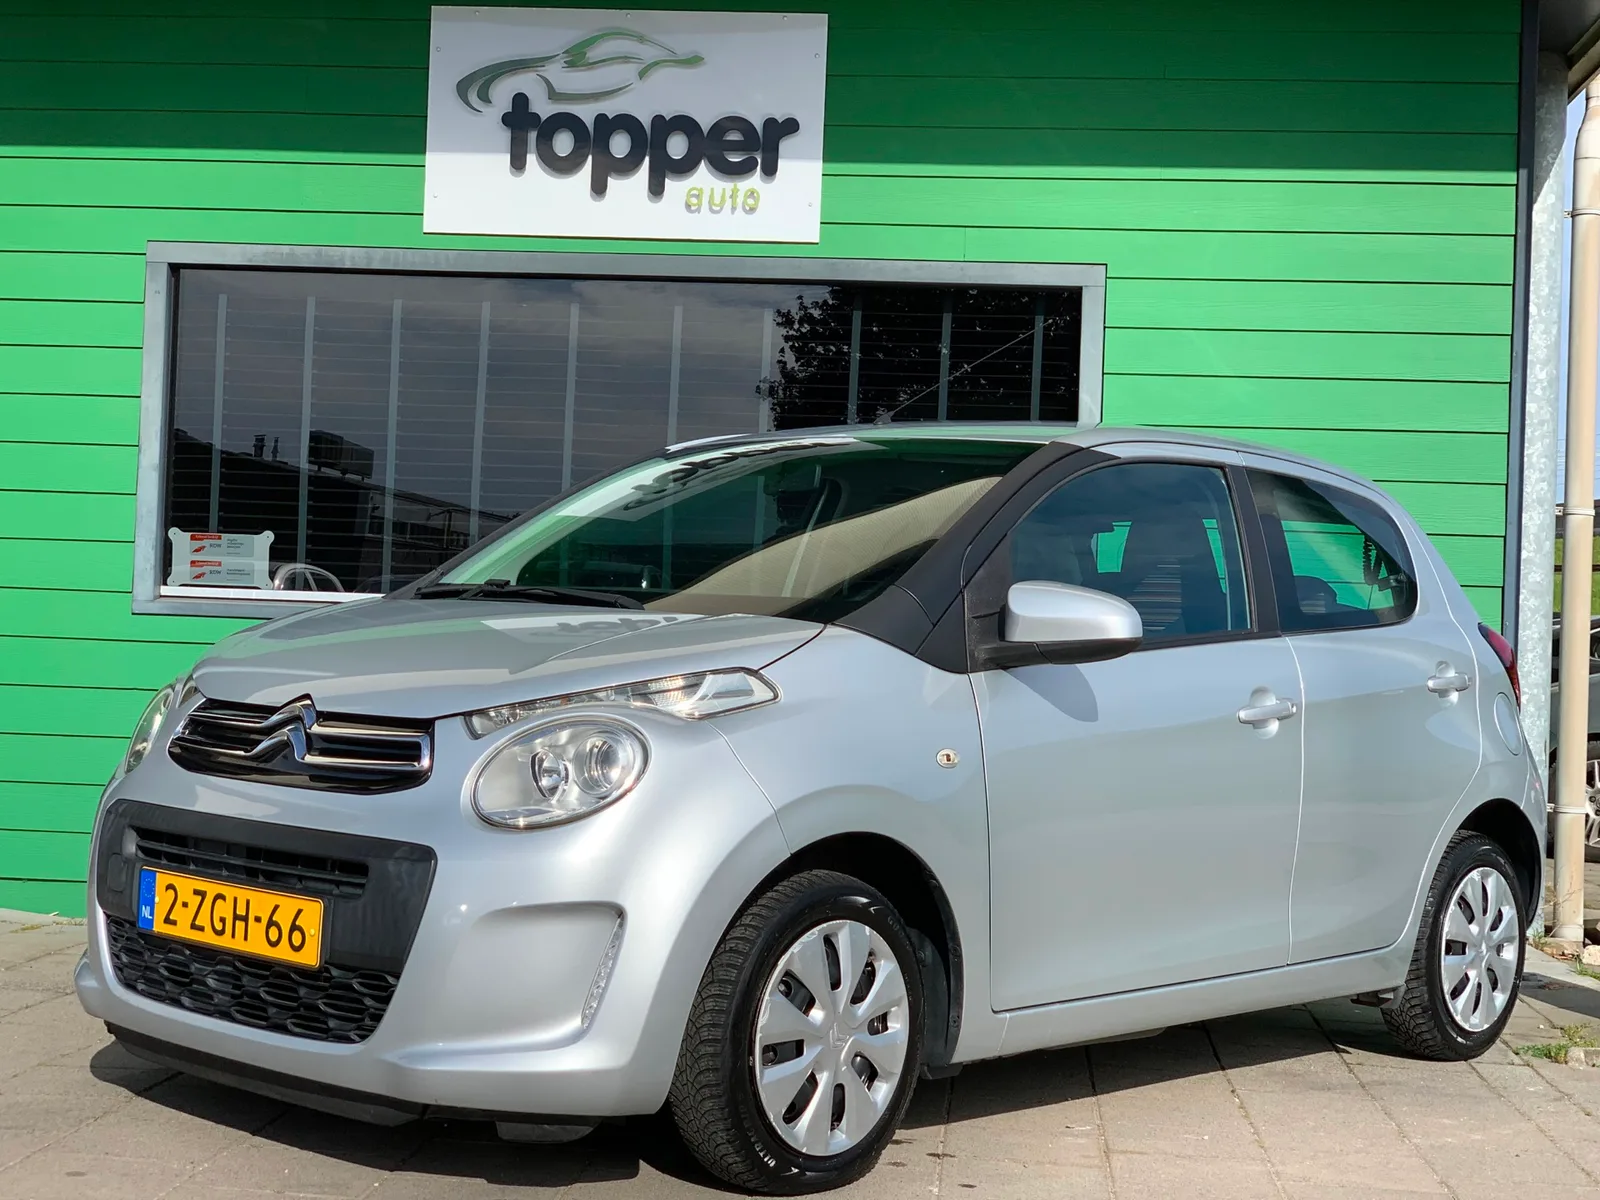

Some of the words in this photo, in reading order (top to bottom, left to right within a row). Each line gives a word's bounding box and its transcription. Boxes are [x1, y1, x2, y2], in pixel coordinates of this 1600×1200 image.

[501, 92, 800, 196] topper
[685, 183, 761, 210] auto
[141, 904, 153, 920] NL
[163, 883, 307, 953] 2-ZGH-66
